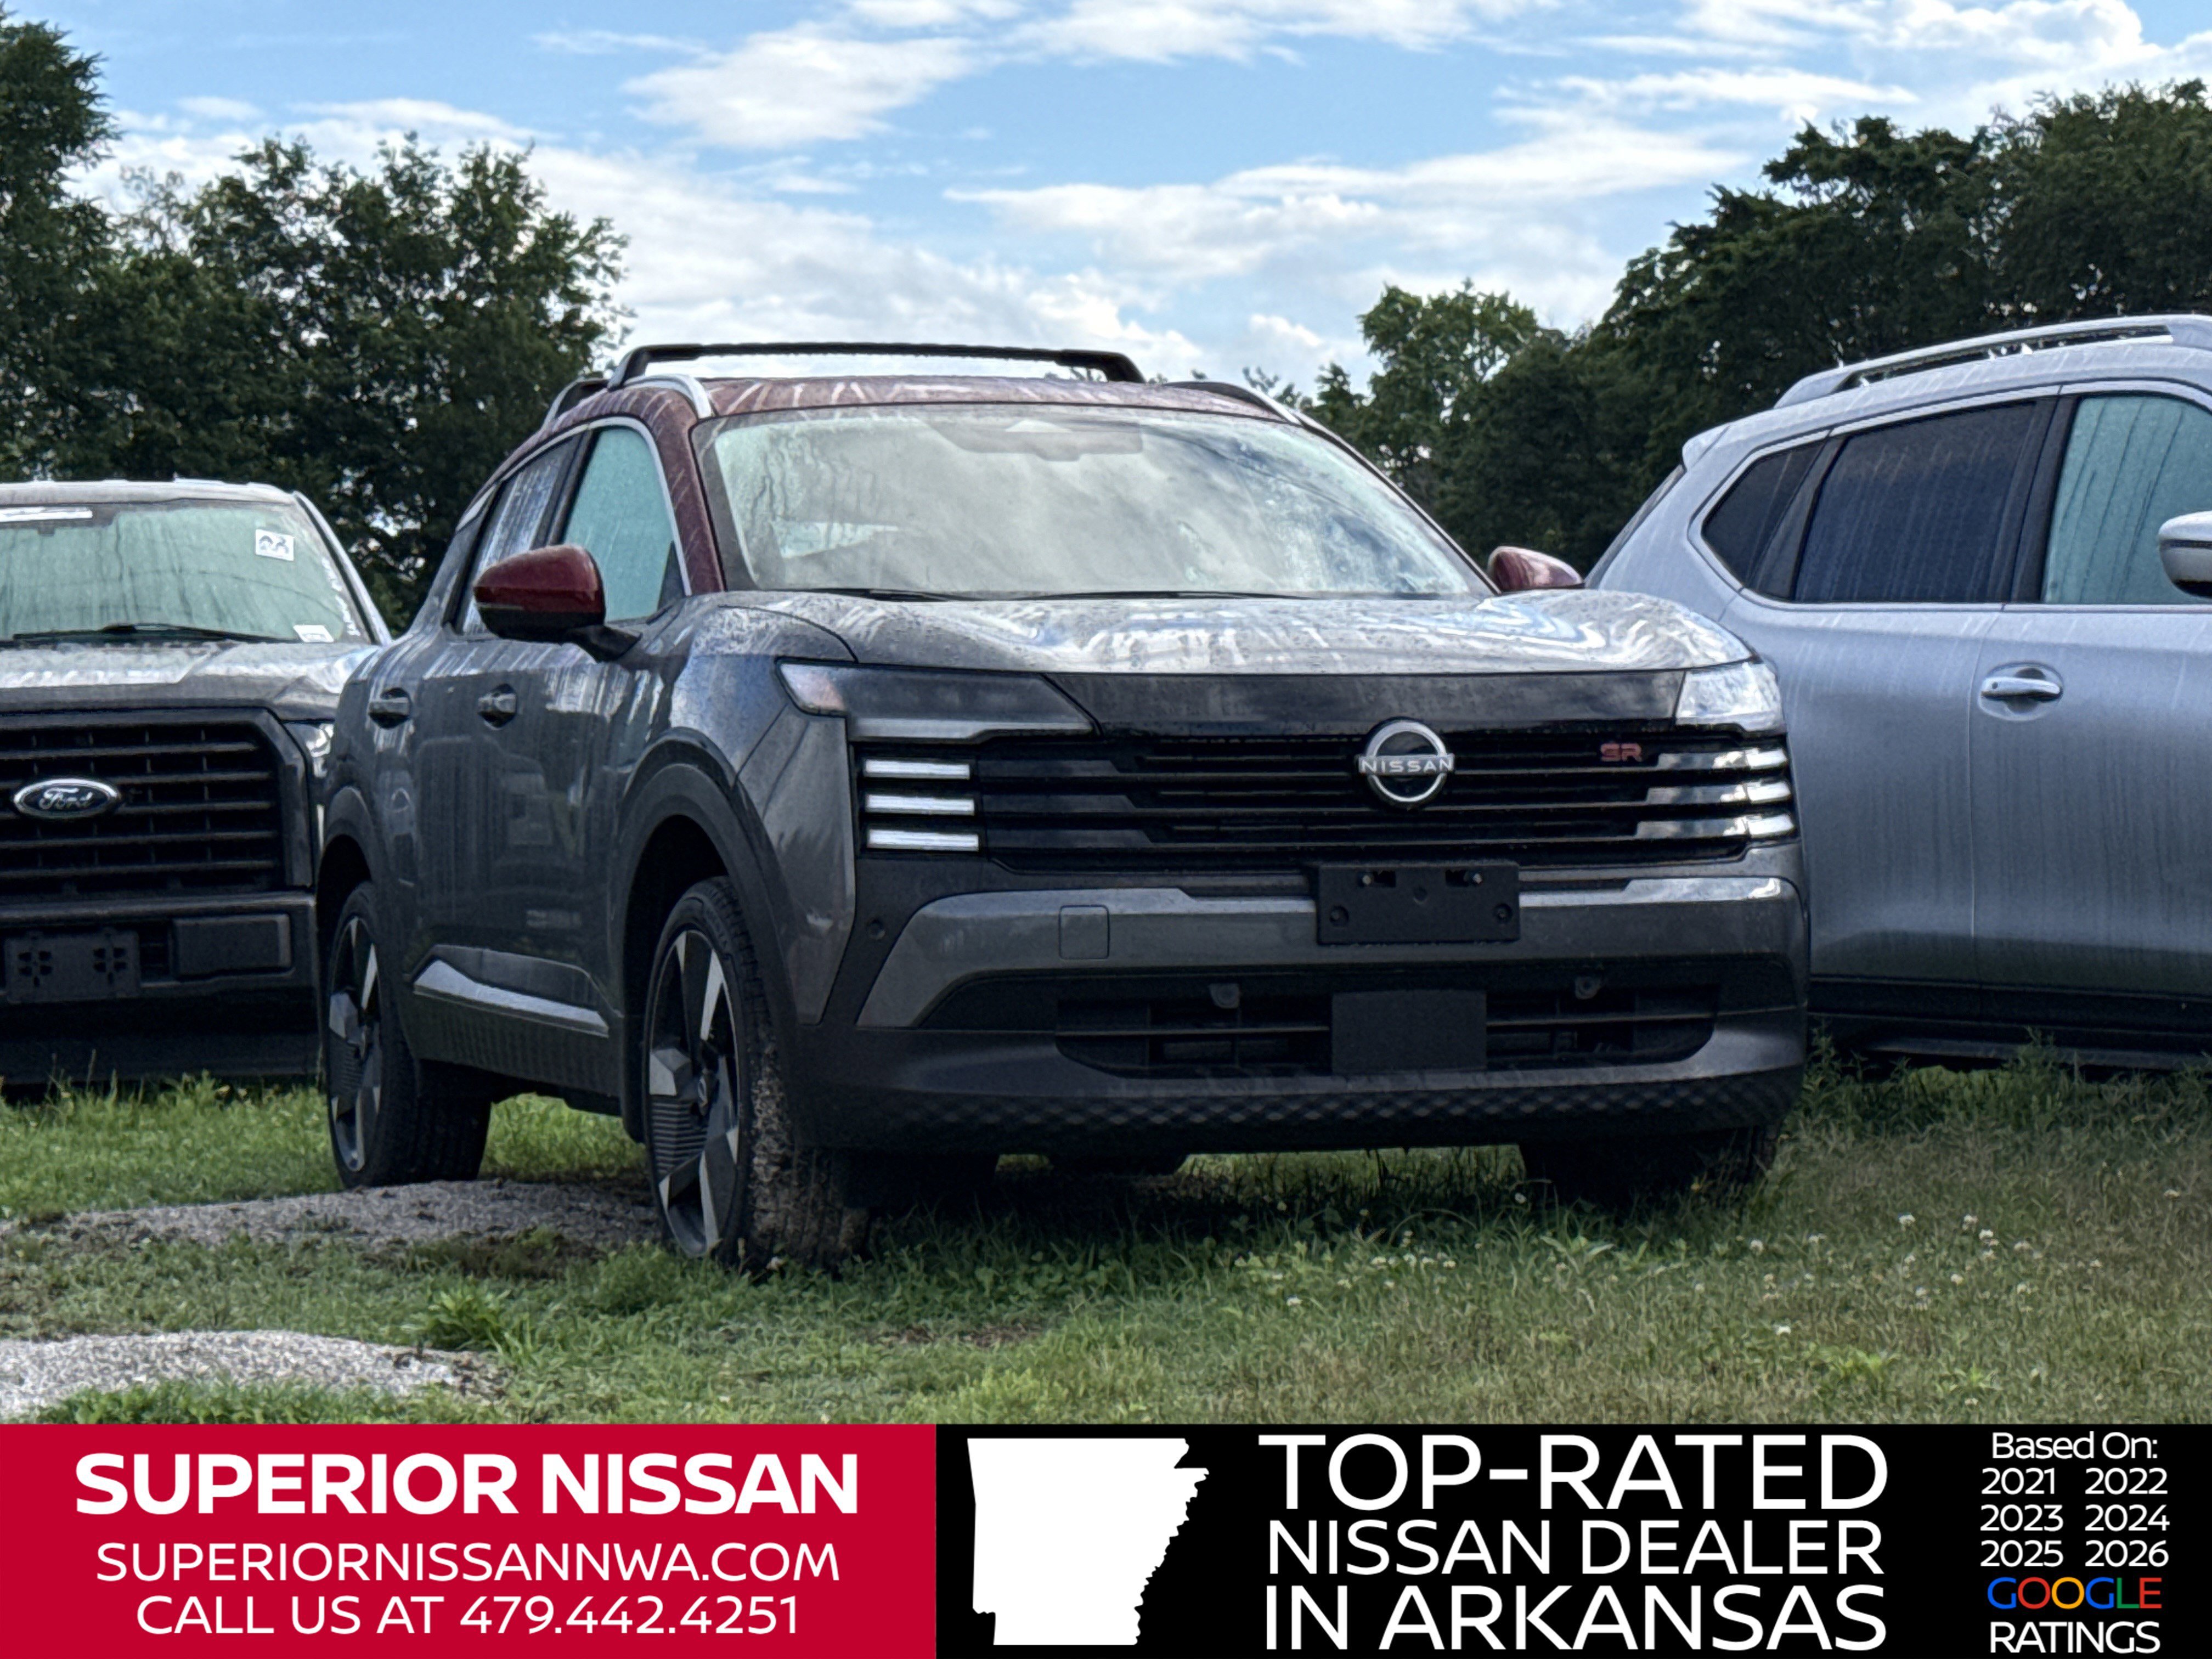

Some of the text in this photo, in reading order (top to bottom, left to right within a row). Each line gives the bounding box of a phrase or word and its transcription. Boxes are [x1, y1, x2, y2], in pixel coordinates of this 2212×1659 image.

[1600, 743, 1642, 762] SR
[1361, 758, 1453, 774] NISSAN
[39, 787, 94, 810] Ford
